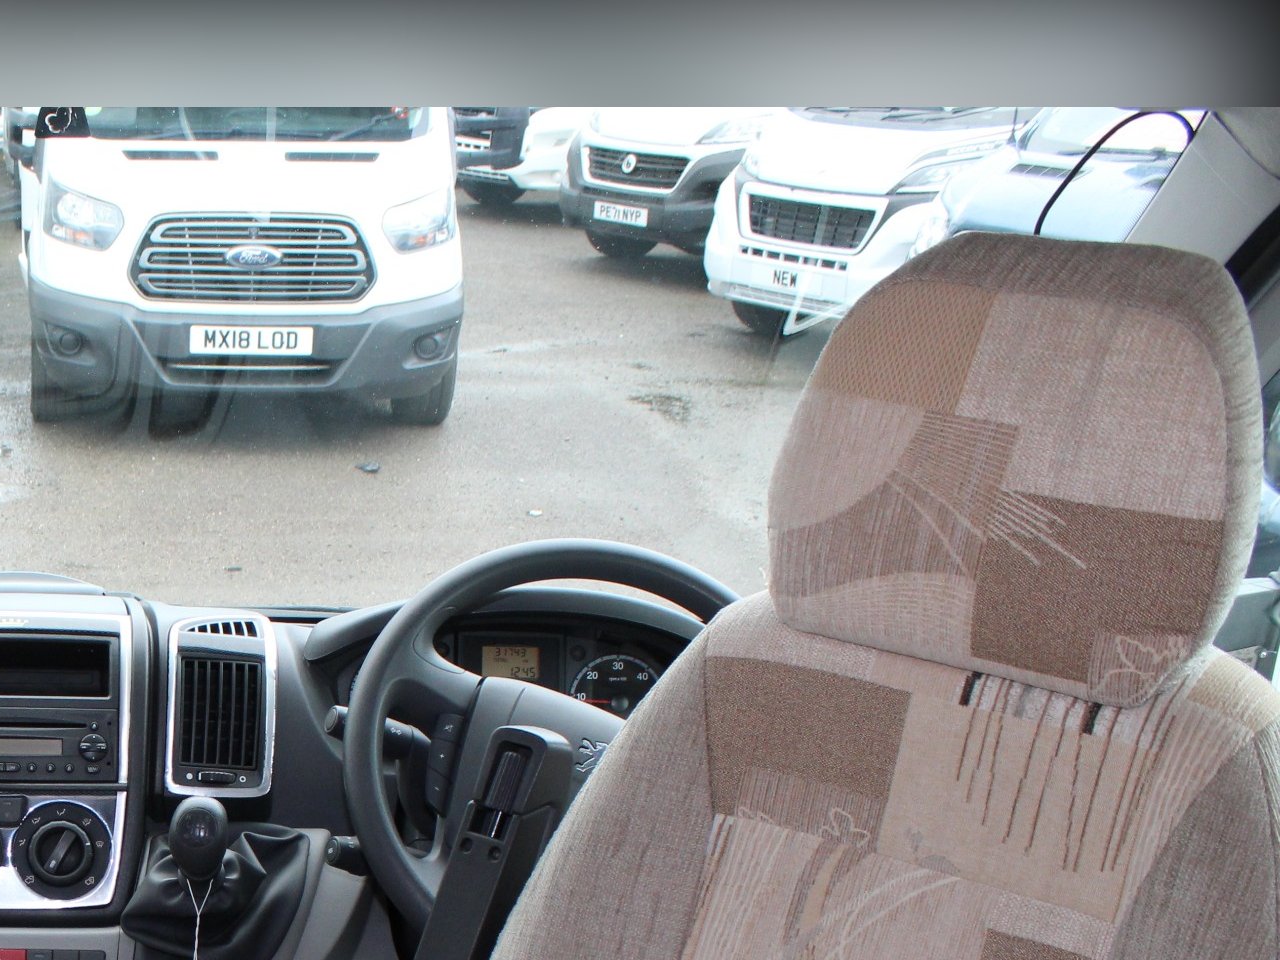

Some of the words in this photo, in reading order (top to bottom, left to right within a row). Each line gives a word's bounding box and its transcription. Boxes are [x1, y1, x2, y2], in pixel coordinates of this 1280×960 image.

[600, 204, 620, 219] PE71
[622, 207, 641, 223] NYP
[773, 269, 798, 288] NEW
[204, 330, 250, 349] MX18
[257, 330, 298, 350] LOD
[612, 661, 624, 671] 30
[586, 671, 599, 680] 20
[636, 672, 649, 681] 40
[577, 692, 586, 701] 10
